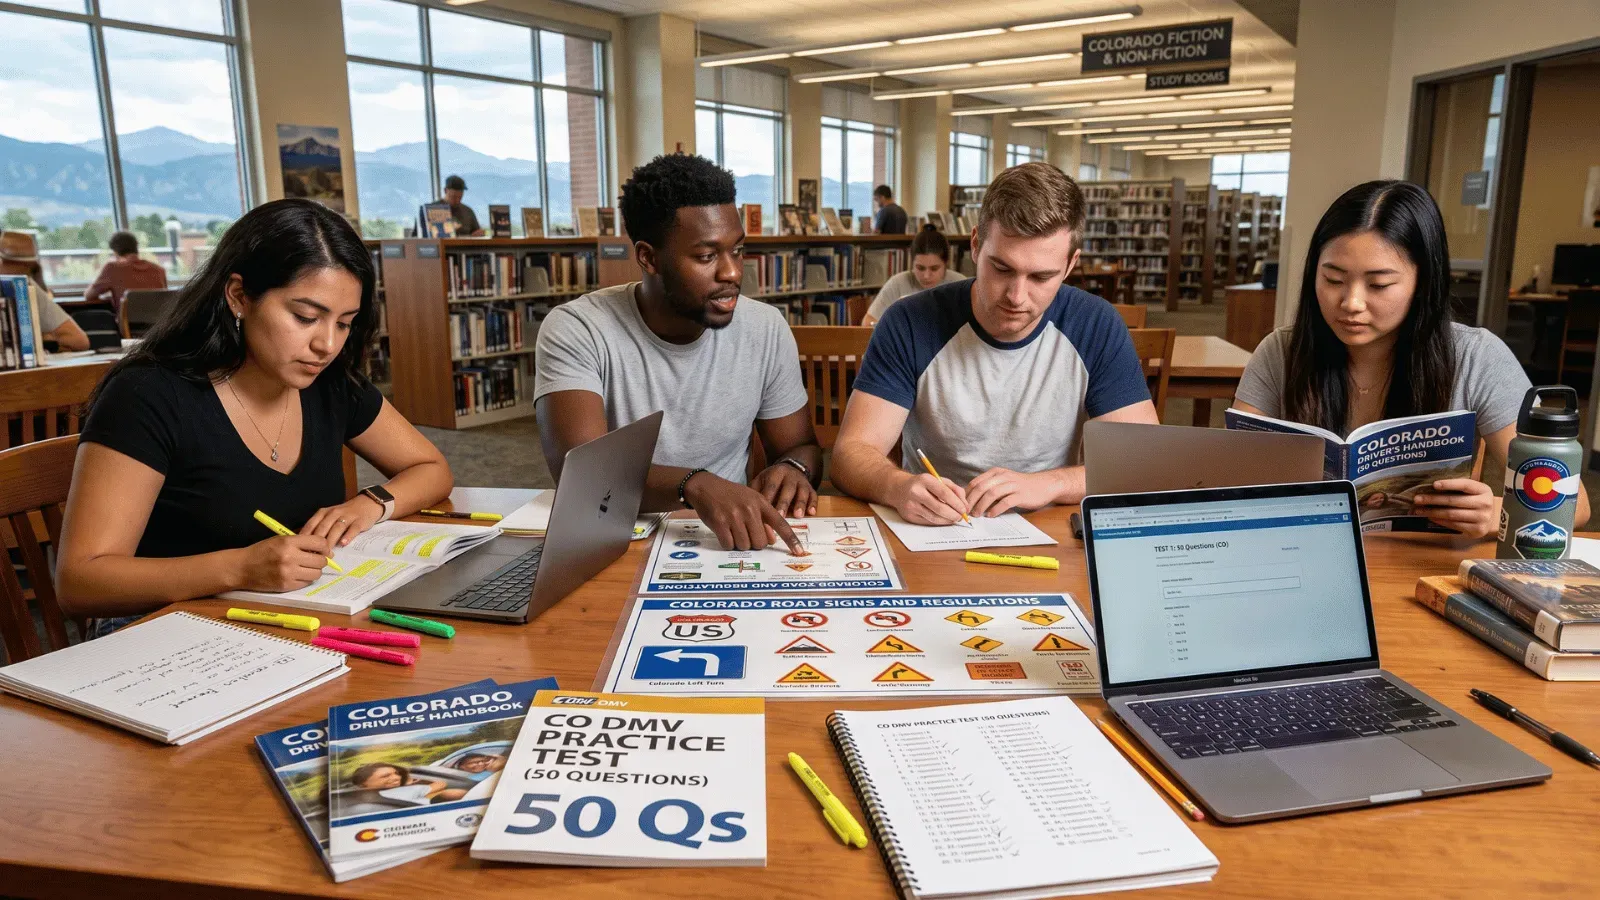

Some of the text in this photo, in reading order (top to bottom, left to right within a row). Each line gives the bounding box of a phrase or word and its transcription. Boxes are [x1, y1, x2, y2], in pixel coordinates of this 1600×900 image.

[1088, 27, 1224, 52] COLORADO FICTION
[1103, 43, 1207, 65] & NON-FICTION
[1150, 71, 1225, 87] STUDY ROOMS
[1357, 424, 1451, 455] COLORADO
[1357, 446, 1400, 465] DRIVER'S
[1403, 435, 1465, 452] HANDBOOK
[1357, 462, 1370, 474] (50
[1372, 450, 1427, 467] QUESTIONS)
[1185, 542, 1215, 551] Questions
[1216, 541, 1229, 549] (CO)
[669, 596, 1041, 609] COLORADO ROAD SIGNS AND REGULATIONS
[674, 624, 723, 638] US
[347, 690, 513, 721] COLORADO
[348, 701, 523, 732] DRIVER'S HANDBOOK
[543, 714, 684, 733] CO DMV
[914, 718, 957, 727] PRACTICE
[996, 710, 1051, 720] QUESTIONS)
[535, 730, 726, 752] PRACTICE
[531, 748, 629, 768] TEST
[523, 768, 709, 788] (50 QUESTIONS)
[503, 792, 747, 850] 50 Qs
